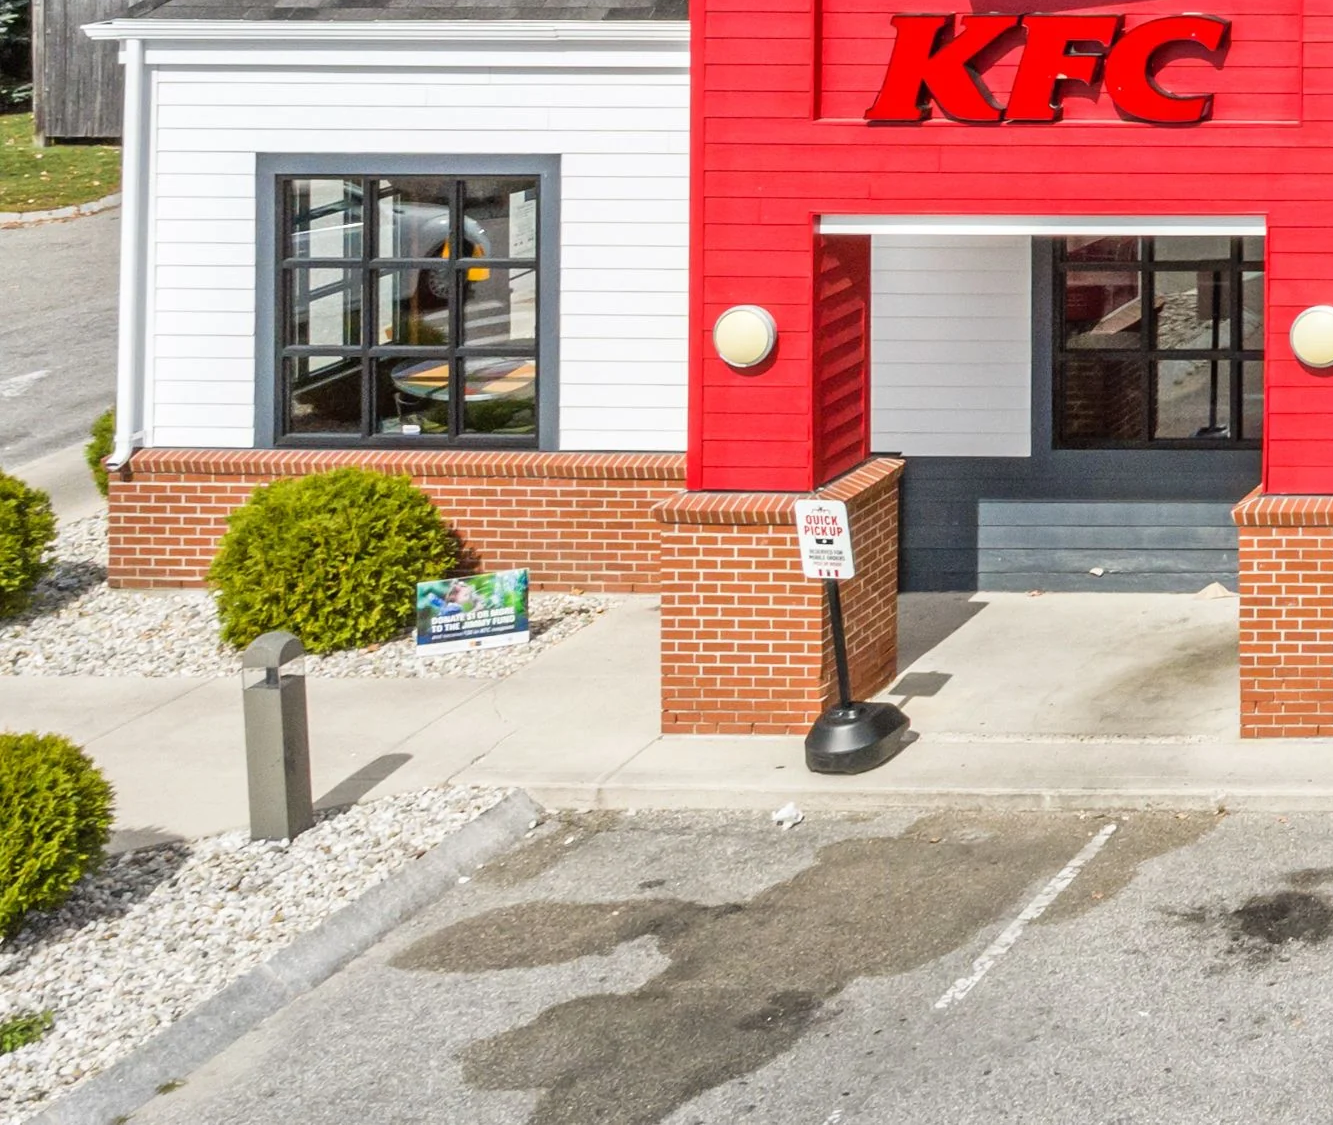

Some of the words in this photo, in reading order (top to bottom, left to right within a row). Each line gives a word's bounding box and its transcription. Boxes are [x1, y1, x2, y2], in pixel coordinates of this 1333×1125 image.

[864, 14, 1231, 125] KFC
[805, 515, 838, 525] QUICK
[431, 613, 464, 625] DONATE
[477, 610, 489, 619] OR
[431, 625, 443, 633] TO
[445, 623, 460, 632] THE
[493, 615, 516, 626] FUND
